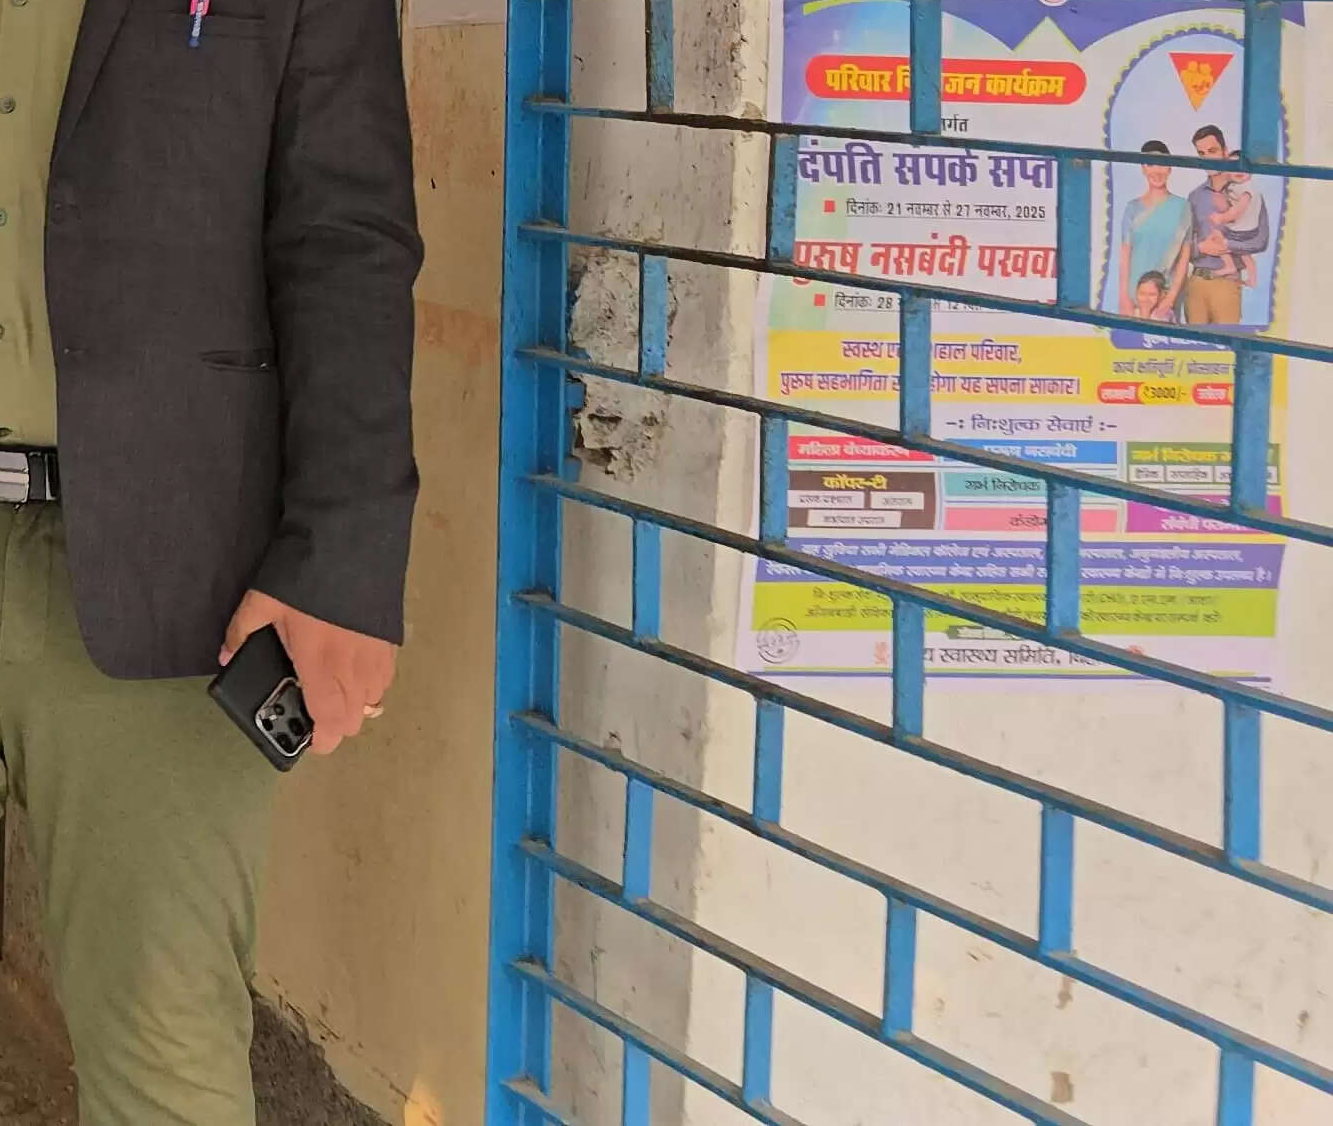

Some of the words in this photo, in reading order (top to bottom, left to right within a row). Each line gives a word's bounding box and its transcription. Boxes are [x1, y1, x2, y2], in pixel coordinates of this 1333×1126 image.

[825, 63, 894, 93] परिवार
[896, 64, 981, 96] निजन
[985, 67, 1066, 98] कार्यक्रम
[797, 138, 883, 185] दंपति
[988, 155, 1057, 190] सप्त
[887, 202, 903, 216] 21
[905, 202, 940, 218] नवम्बर
[942, 199, 952, 217] से
[956, 204, 971, 218] 27
[1015, 205, 1047, 220] 2025
[869, 231, 972, 278] नसबंदी
[977, 244, 1058, 279] पखवा
[877, 295, 894, 311] 28
[840, 339, 884, 360] स्वस्थ
[970, 338, 1023, 364] परिवार,
[817, 368, 888, 393] सहभागिता
[959, 374, 983, 394] यह
[985, 375, 1027, 395] सपना
[1029, 376, 1081, 396] साकार।
[1044, 413, 1095, 433] सेवाएं
[939, 646, 999, 665] स्वास्थ्य
[1003, 643, 1061, 666] समिति,
